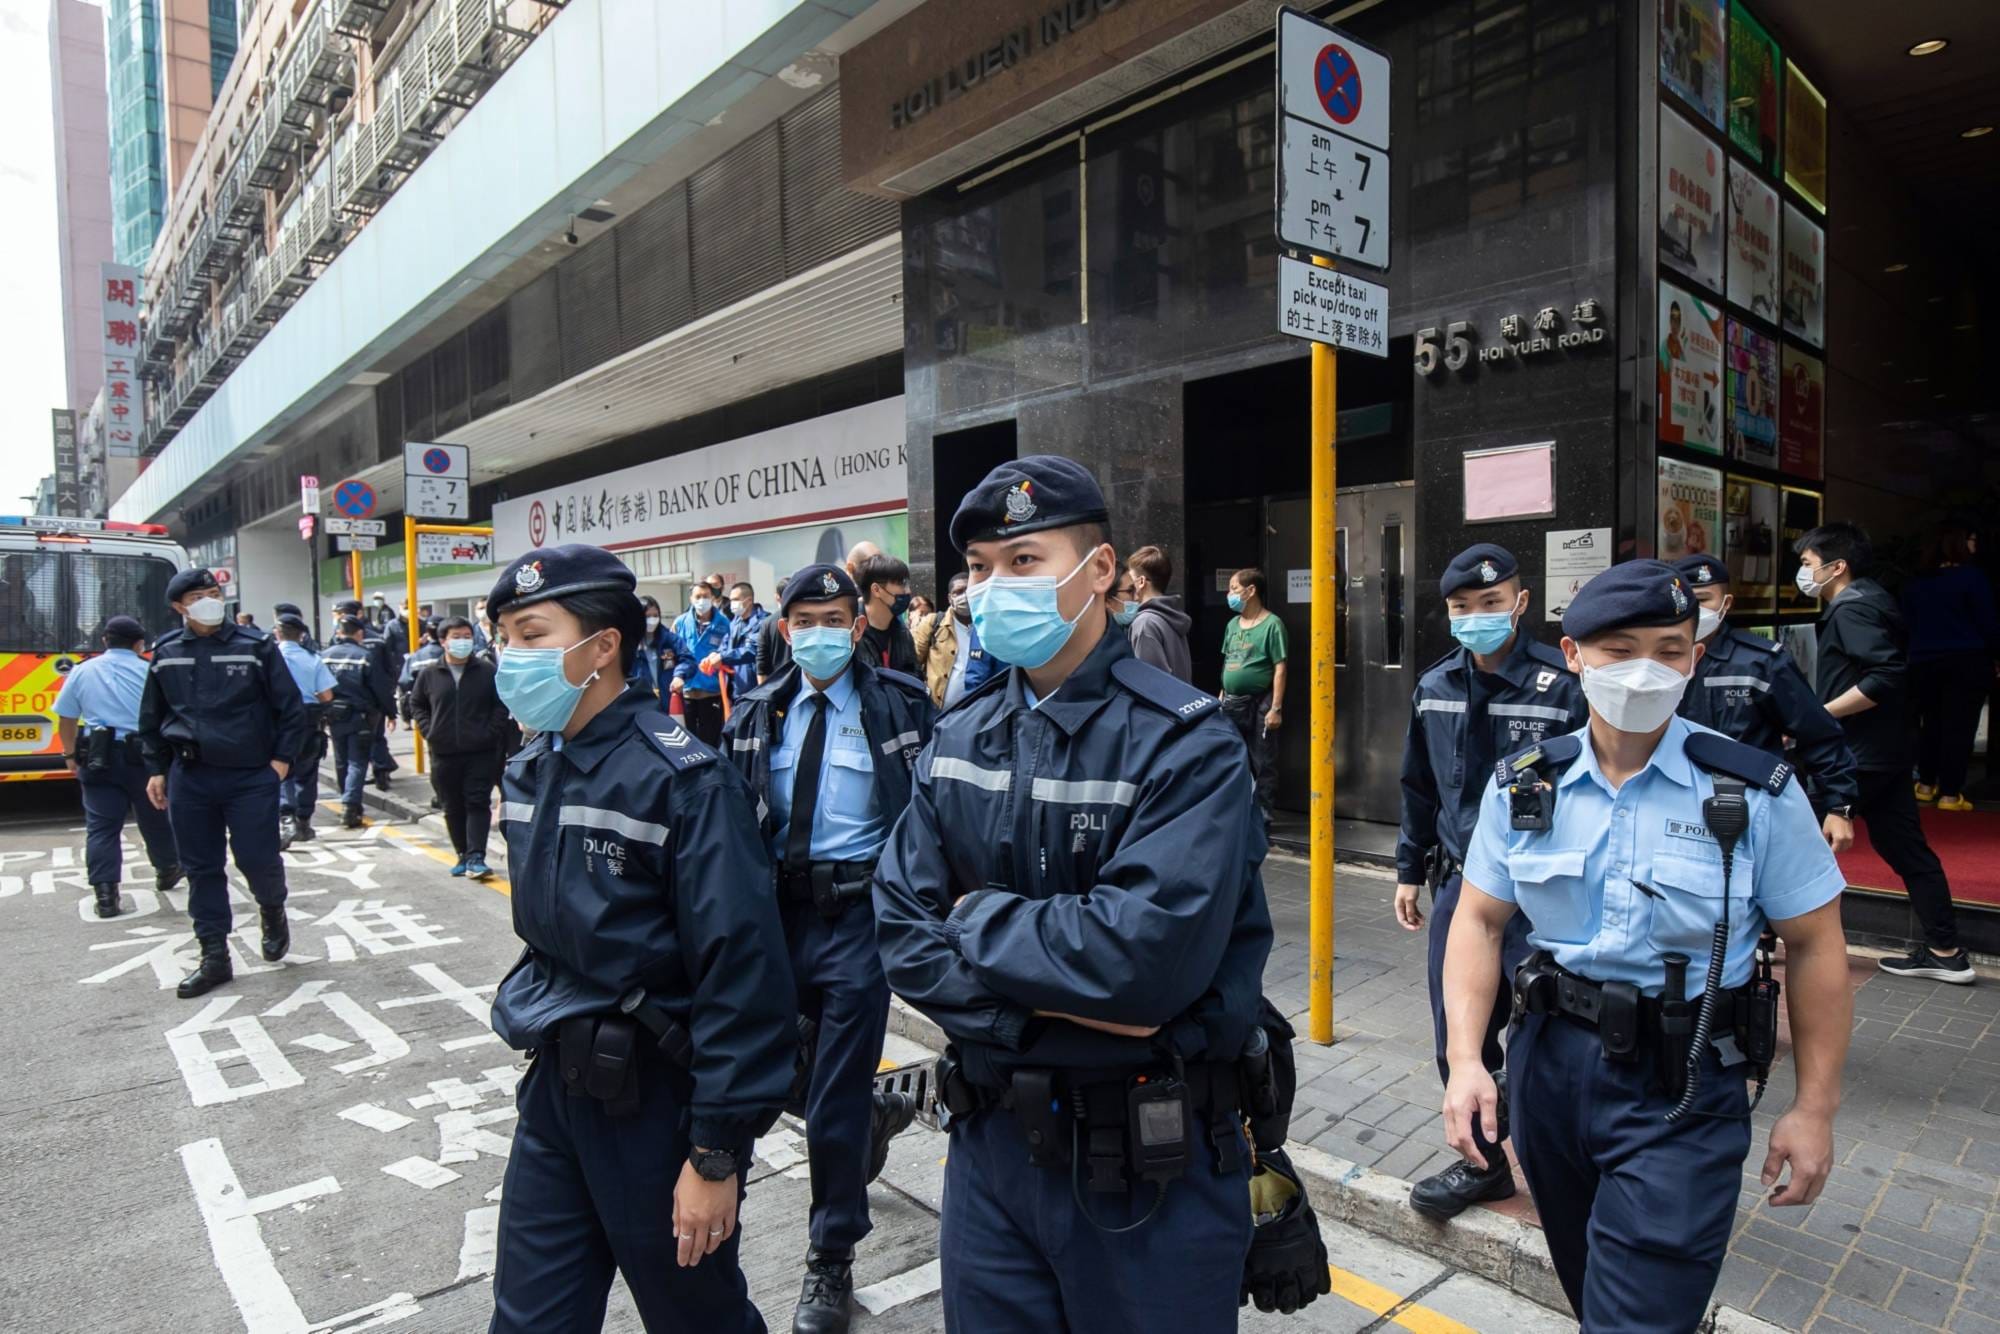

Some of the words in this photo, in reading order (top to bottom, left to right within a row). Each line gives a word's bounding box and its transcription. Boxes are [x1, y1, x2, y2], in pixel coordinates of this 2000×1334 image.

[1311, 133, 1331, 152] am
[1305, 152, 1338, 181] 上午
[1354, 152, 1371, 191] 7
[1311, 199, 1331, 217] pm
[1305, 217, 1337, 246] 下午
[1354, 215, 1370, 254] 7
[1308, 271, 1347, 297] Except
[1348, 283, 1367, 302] taxi
[1293, 289, 1317, 307] pick
[1364, 309, 1378, 323] off
[1287, 307, 1382, 350] 的士上落客除外
[1415, 321, 1472, 377] 55
[1479, 346, 1504, 362] HOI
[1510, 337, 1551, 357] YUEN
[1558, 328, 1604, 349] ROAD
[446, 481, 457, 495] 7
[659, 480, 708, 516] BANK
[714, 473, 740, 505] OF
[748, 456, 827, 500] CHINA
[834, 447, 890, 480] (HONG
[447, 502, 457, 516] 7
[1724, 689, 1750, 698] POLIC
[1508, 720, 1545, 732] POLICE
[680, 751, 707, 764] 7531
[1769, 763, 1789, 788] 27372
[1069, 812, 1107, 830] POLI
[583, 836, 627, 860] OLICE
